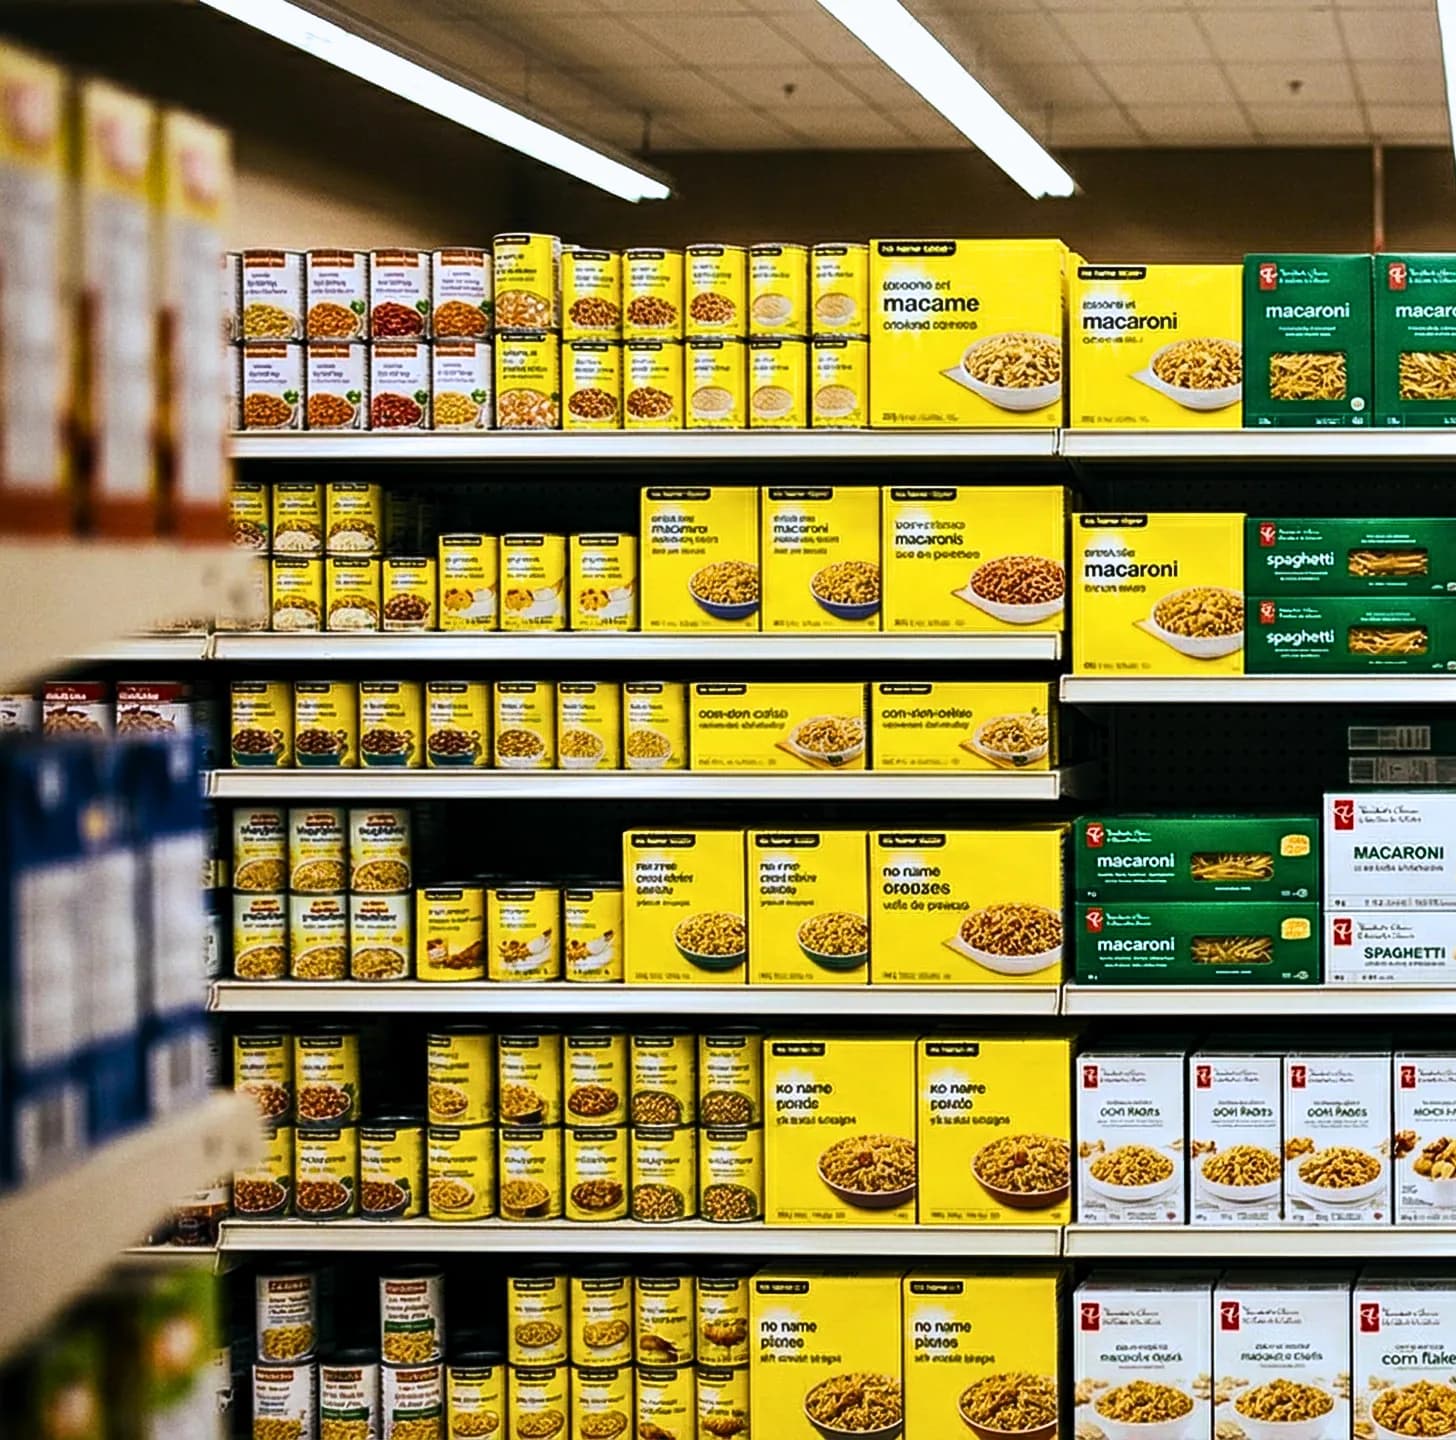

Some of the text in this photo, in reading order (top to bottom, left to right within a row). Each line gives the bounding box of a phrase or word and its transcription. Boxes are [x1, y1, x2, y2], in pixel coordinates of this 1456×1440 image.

[883, 296, 980, 314] macame
[1265, 302, 1350, 319] macaroni
[1082, 312, 1178, 330] macaroni
[1266, 551, 1334, 568] spaghetti
[1084, 559, 1178, 578] macaroni
[1266, 629, 1334, 646] spaghetti
[1097, 852, 1175, 869] macaroni
[1353, 846, 1444, 860] MACARONI
[1097, 936, 1175, 952] macaroni
[1364, 947, 1446, 959] SPAGHETTI
[761, 1321, 817, 1332] no name
[915, 1321, 971, 1332] no name
